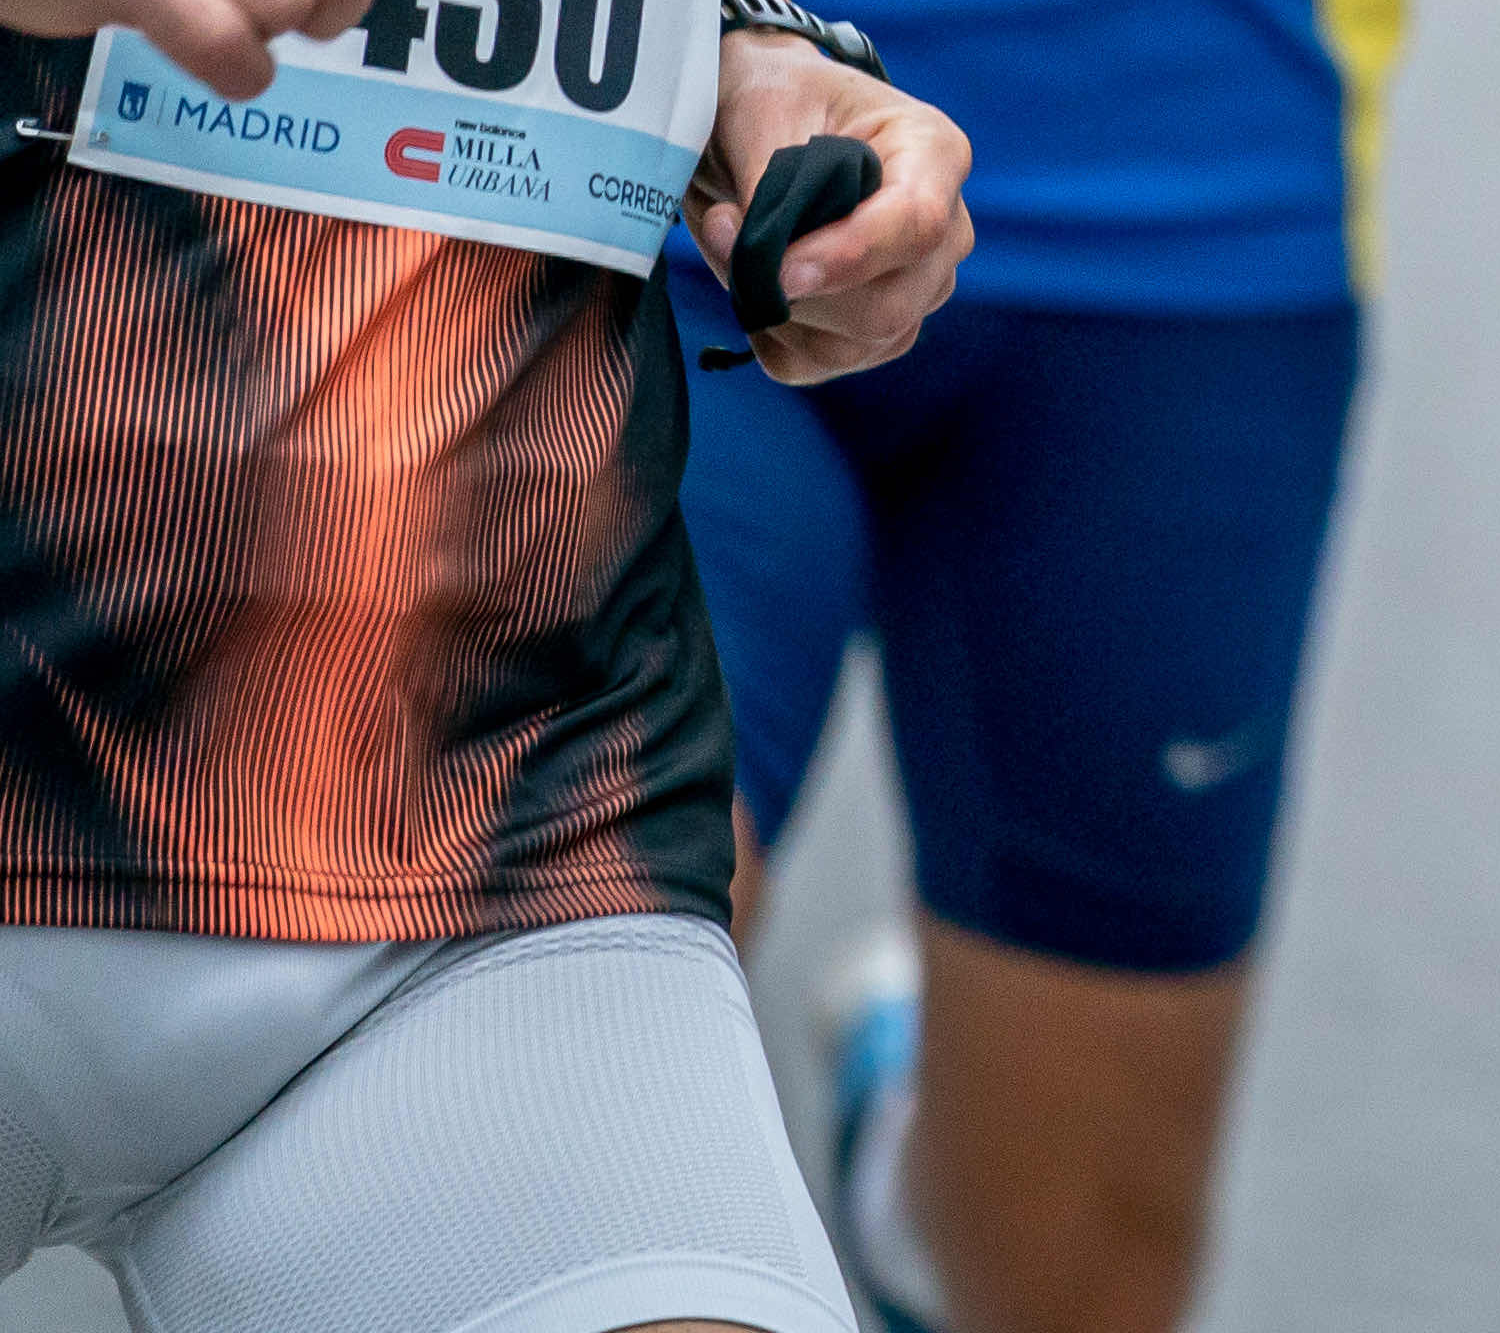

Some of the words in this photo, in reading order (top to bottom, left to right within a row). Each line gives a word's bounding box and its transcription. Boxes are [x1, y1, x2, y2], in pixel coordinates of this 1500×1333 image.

[173, 97, 341, 154] MADRID
[450, 135, 541, 172] MILLA
[448, 164, 550, 203] URBANA
